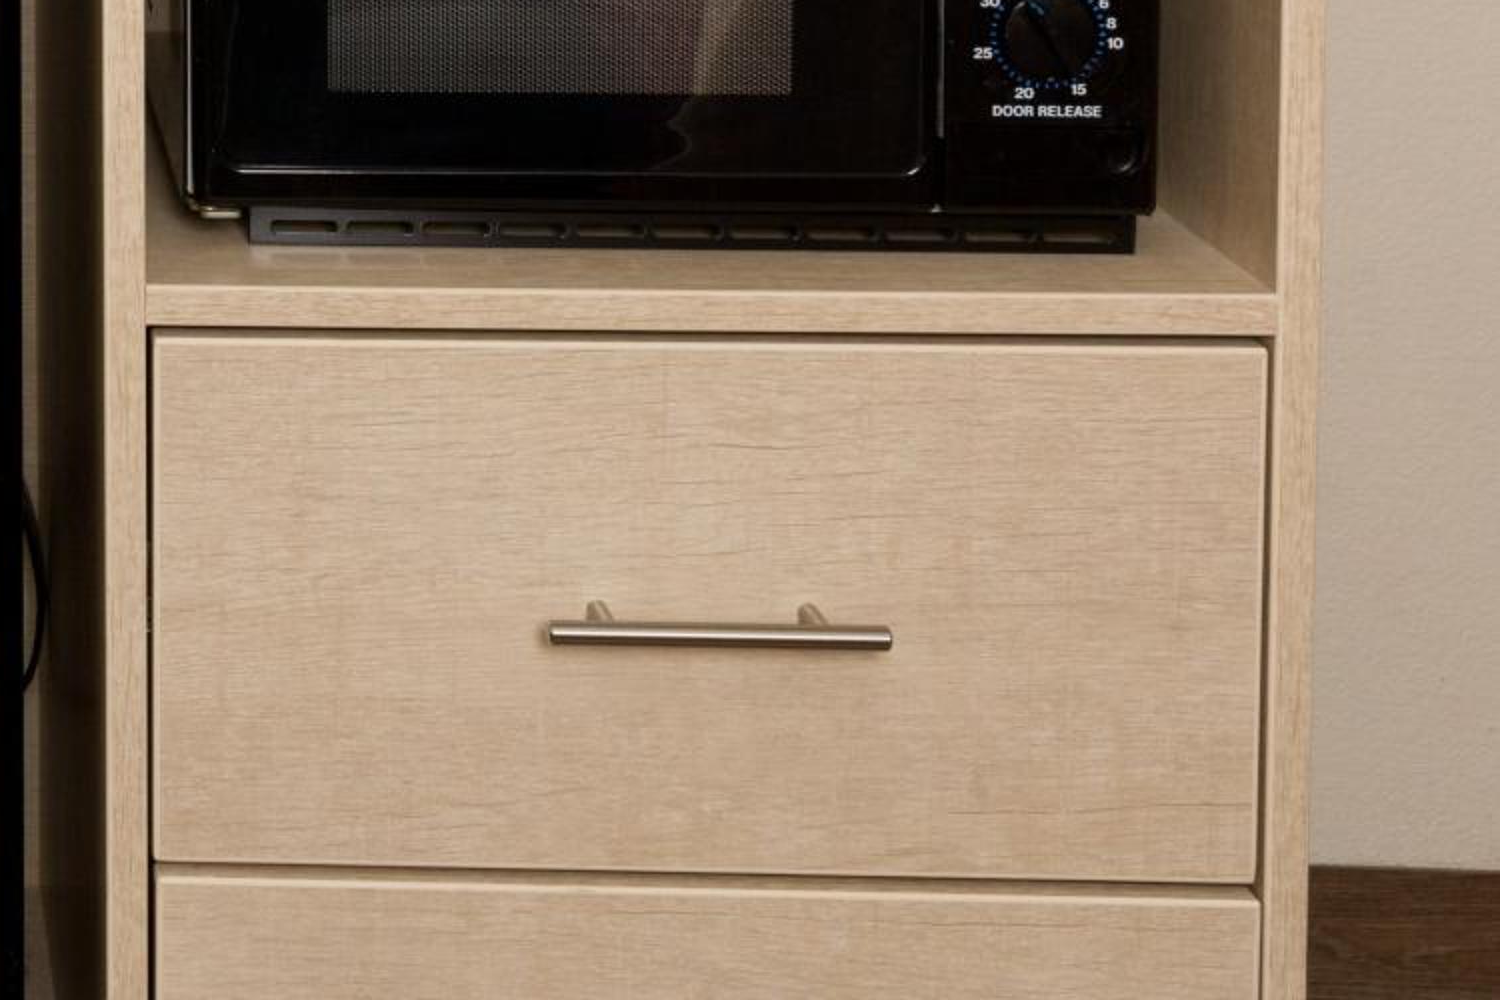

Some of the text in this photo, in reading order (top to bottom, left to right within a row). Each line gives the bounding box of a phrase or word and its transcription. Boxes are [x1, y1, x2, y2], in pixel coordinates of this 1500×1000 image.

[1106, 17, 1118, 30] 8
[1107, 37, 1125, 50] 10
[972, 47, 994, 60] 25
[1013, 87, 1035, 100] 20
[1070, 83, 1088, 96] 15
[992, 105, 1103, 118] DOOR RELEASE
